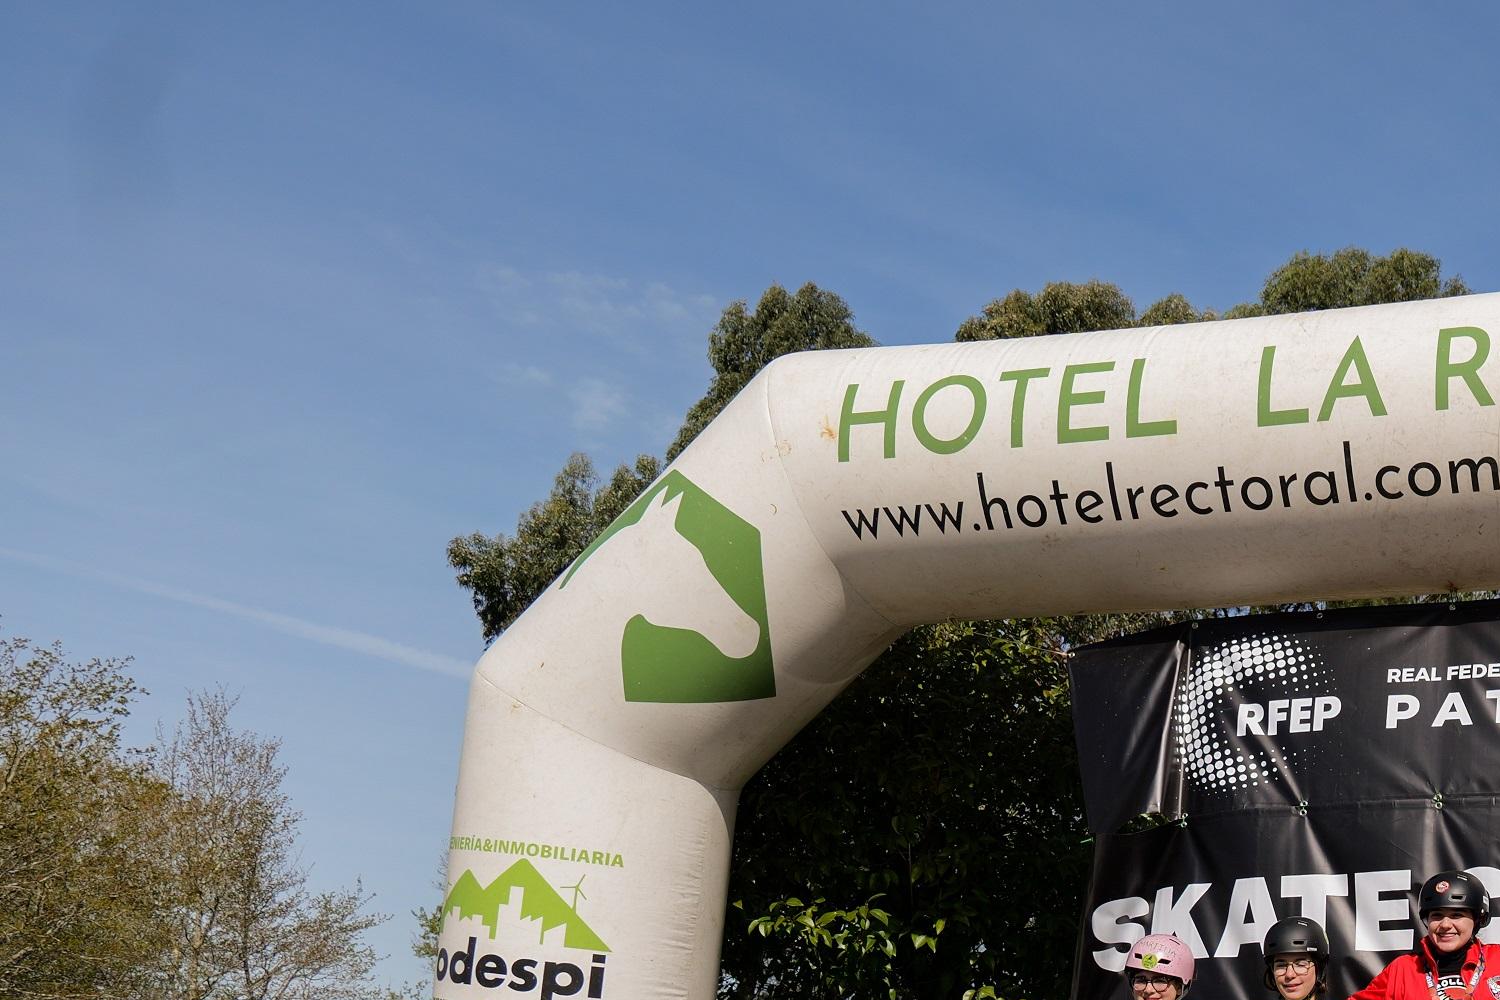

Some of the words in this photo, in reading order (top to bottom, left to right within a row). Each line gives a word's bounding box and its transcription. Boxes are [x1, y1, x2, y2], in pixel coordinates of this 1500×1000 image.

[837, 358, 1178, 462] HOTEL
[1256, 334, 1388, 428] LA
[841, 440, 1500, 541] www.hotelrectoral.com
[1386, 667, 1442, 683] REAL
[1236, 696, 1342, 737] RFEP
